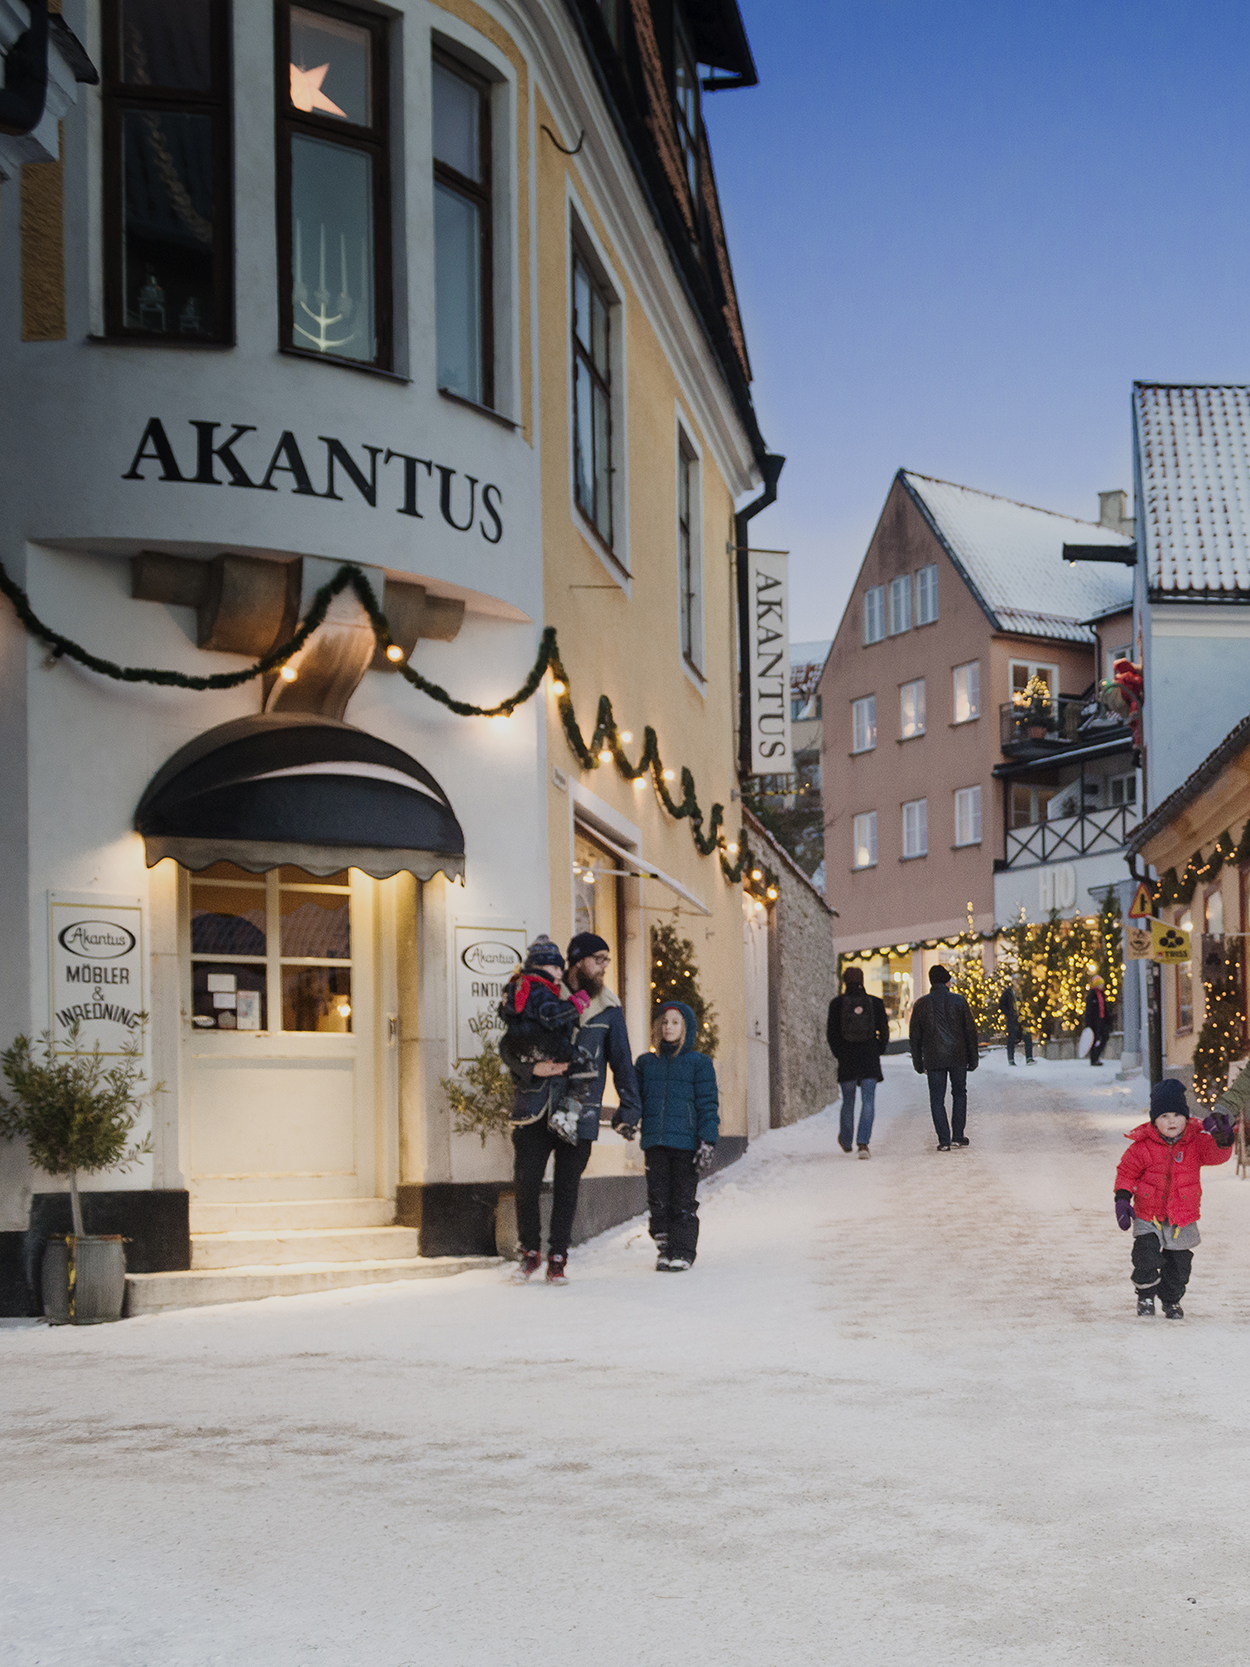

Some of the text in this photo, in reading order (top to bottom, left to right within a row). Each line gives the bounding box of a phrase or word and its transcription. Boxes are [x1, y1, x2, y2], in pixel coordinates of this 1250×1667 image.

[120, 416, 503, 545] AKANTUS
[755, 568, 786, 759] AKANTUS
[68, 927, 126, 951] Akantus
[468, 947, 514, 969] Akantus
[66, 963, 130, 985] MÖBLER
[91, 986, 105, 1002] &
[471, 982, 504, 997] ANTI
[55, 1002, 140, 1029] INREDNING
